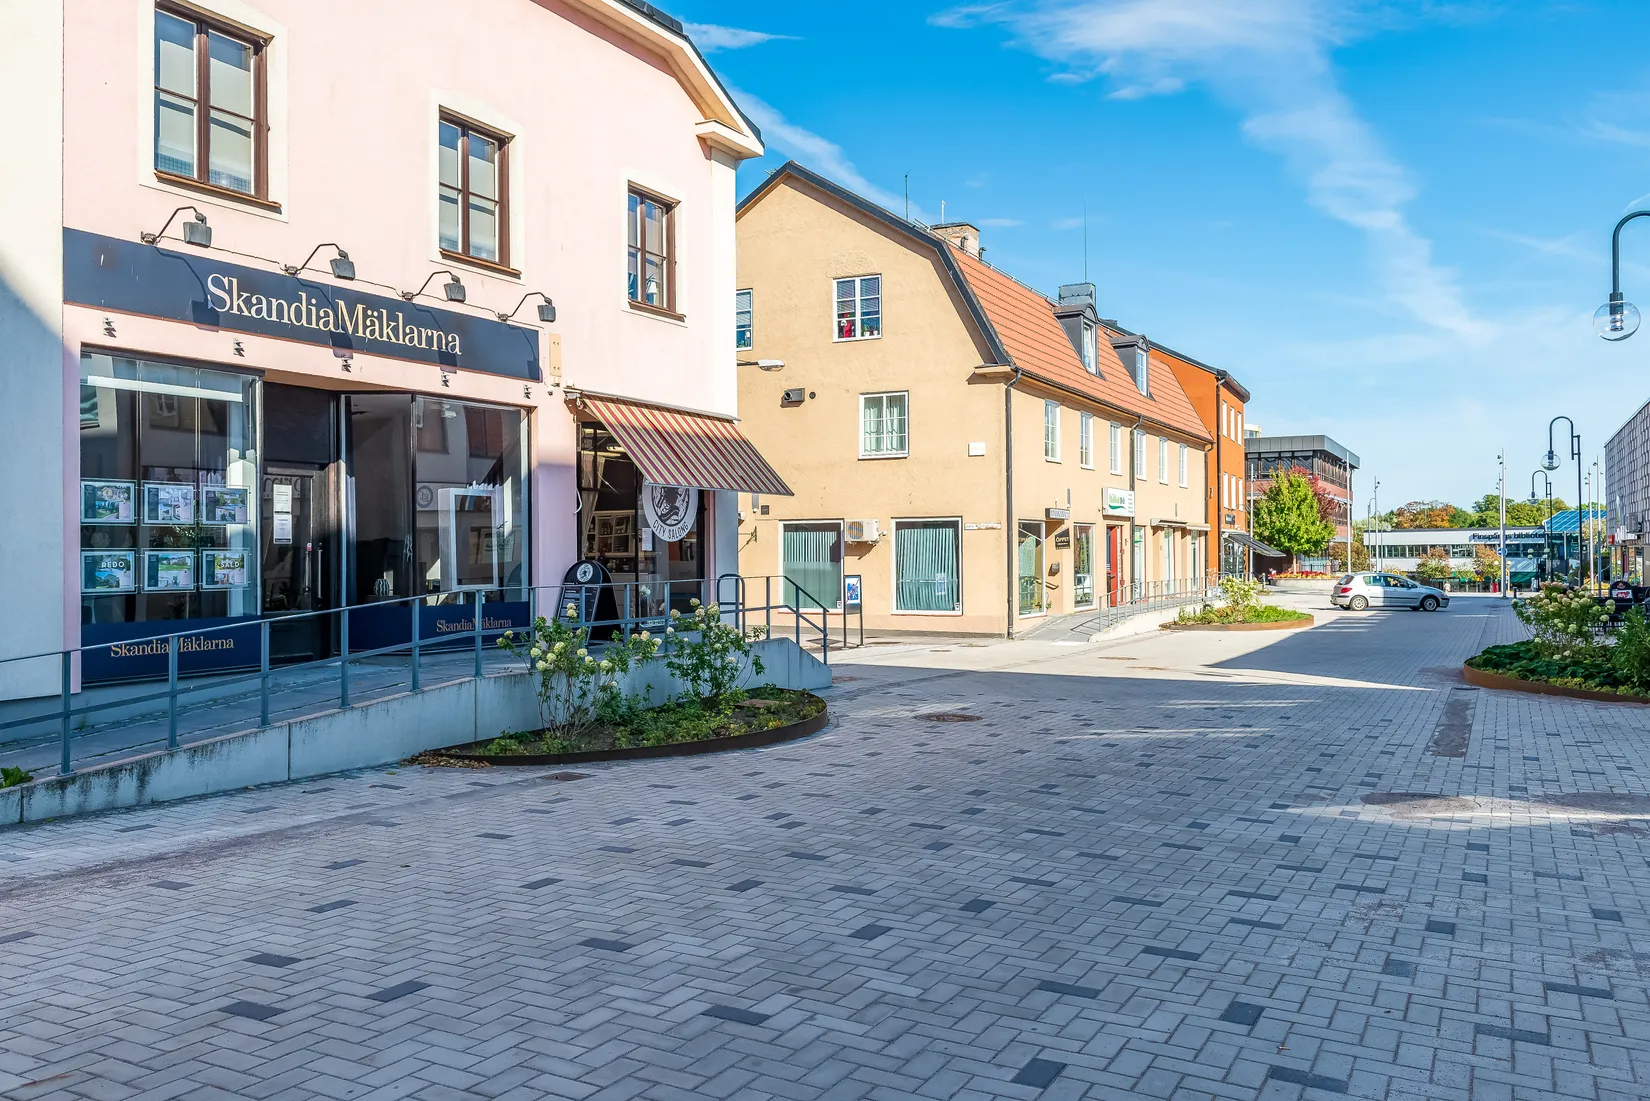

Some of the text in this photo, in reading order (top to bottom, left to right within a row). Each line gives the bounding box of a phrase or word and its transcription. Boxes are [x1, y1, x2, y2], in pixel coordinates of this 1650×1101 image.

[207, 273, 462, 355] SkandiaMäklarna
[652, 519, 667, 537] CITY
[668, 521, 689, 540] SALONG
[436, 617, 512, 632] Skandiaäklarna
